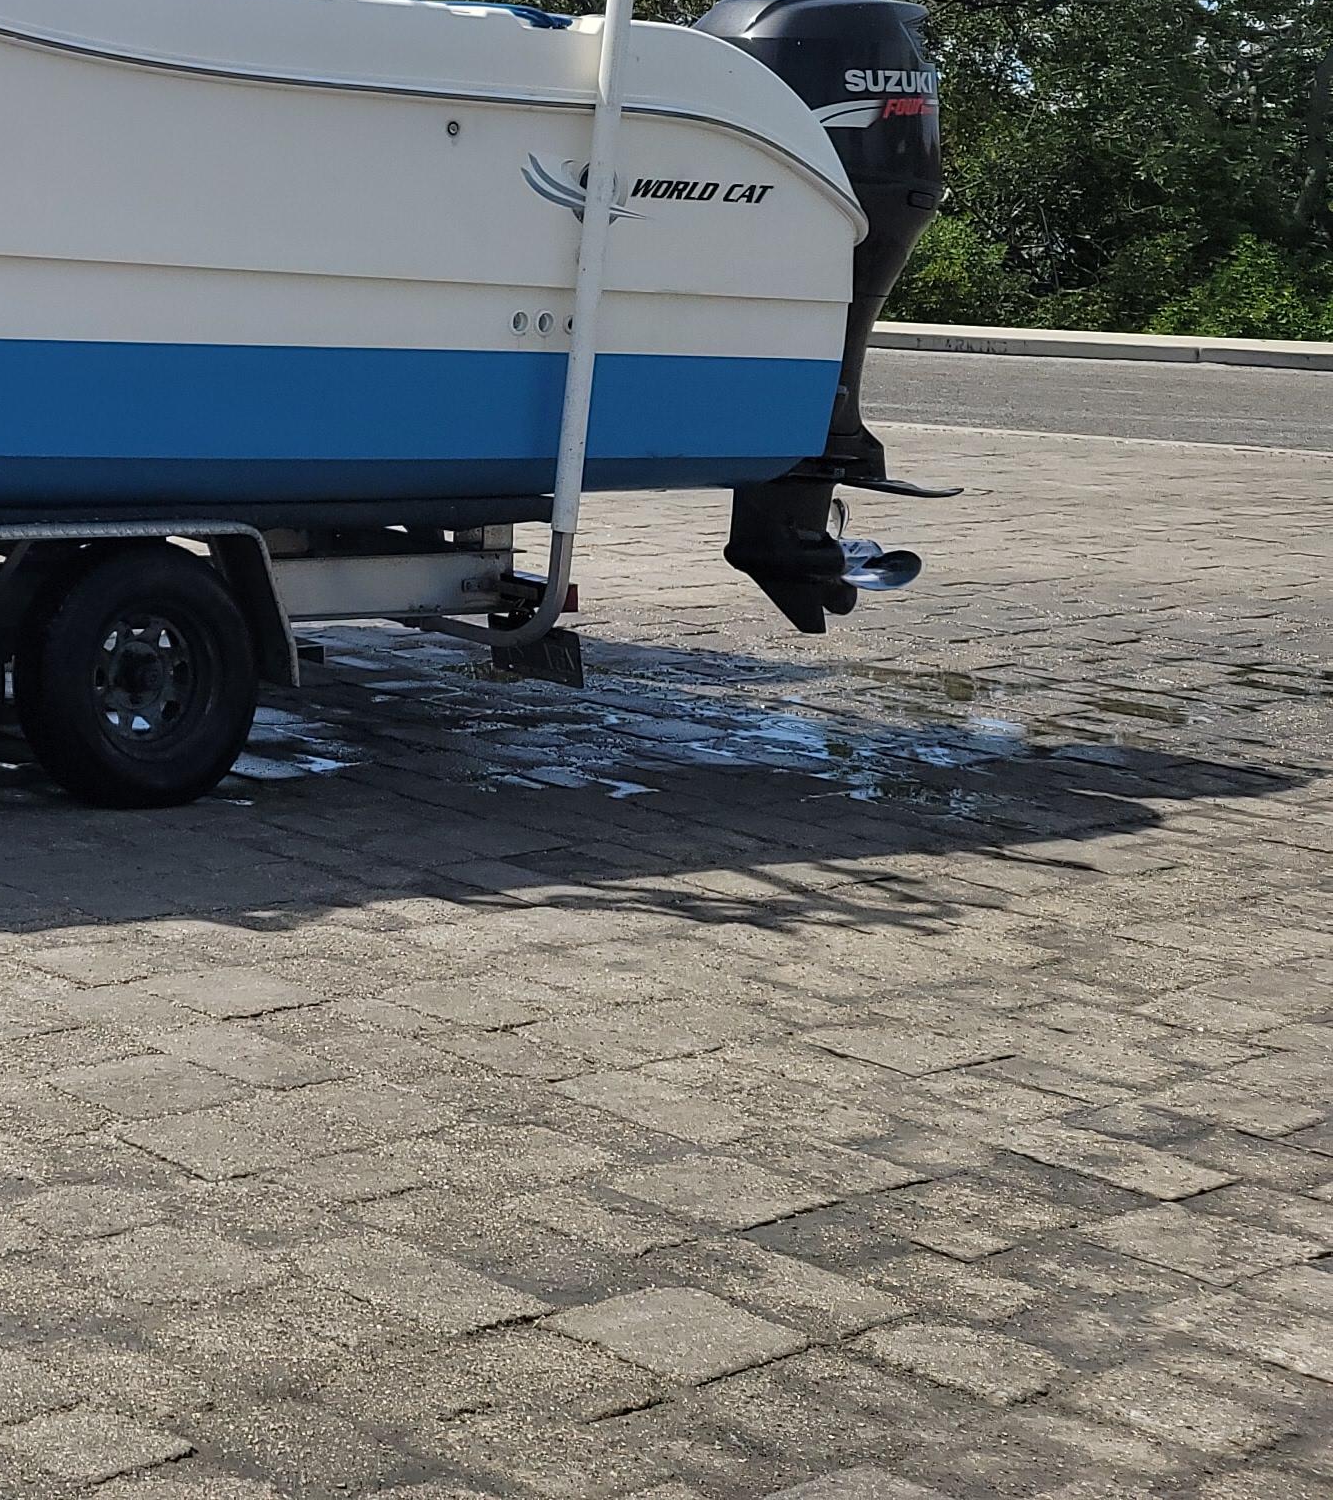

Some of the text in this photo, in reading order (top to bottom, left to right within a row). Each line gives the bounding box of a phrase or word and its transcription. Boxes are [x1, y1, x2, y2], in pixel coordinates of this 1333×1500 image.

[844, 69, 933, 94] SUZUKI
[630, 178, 774, 204] WORLD CAT
